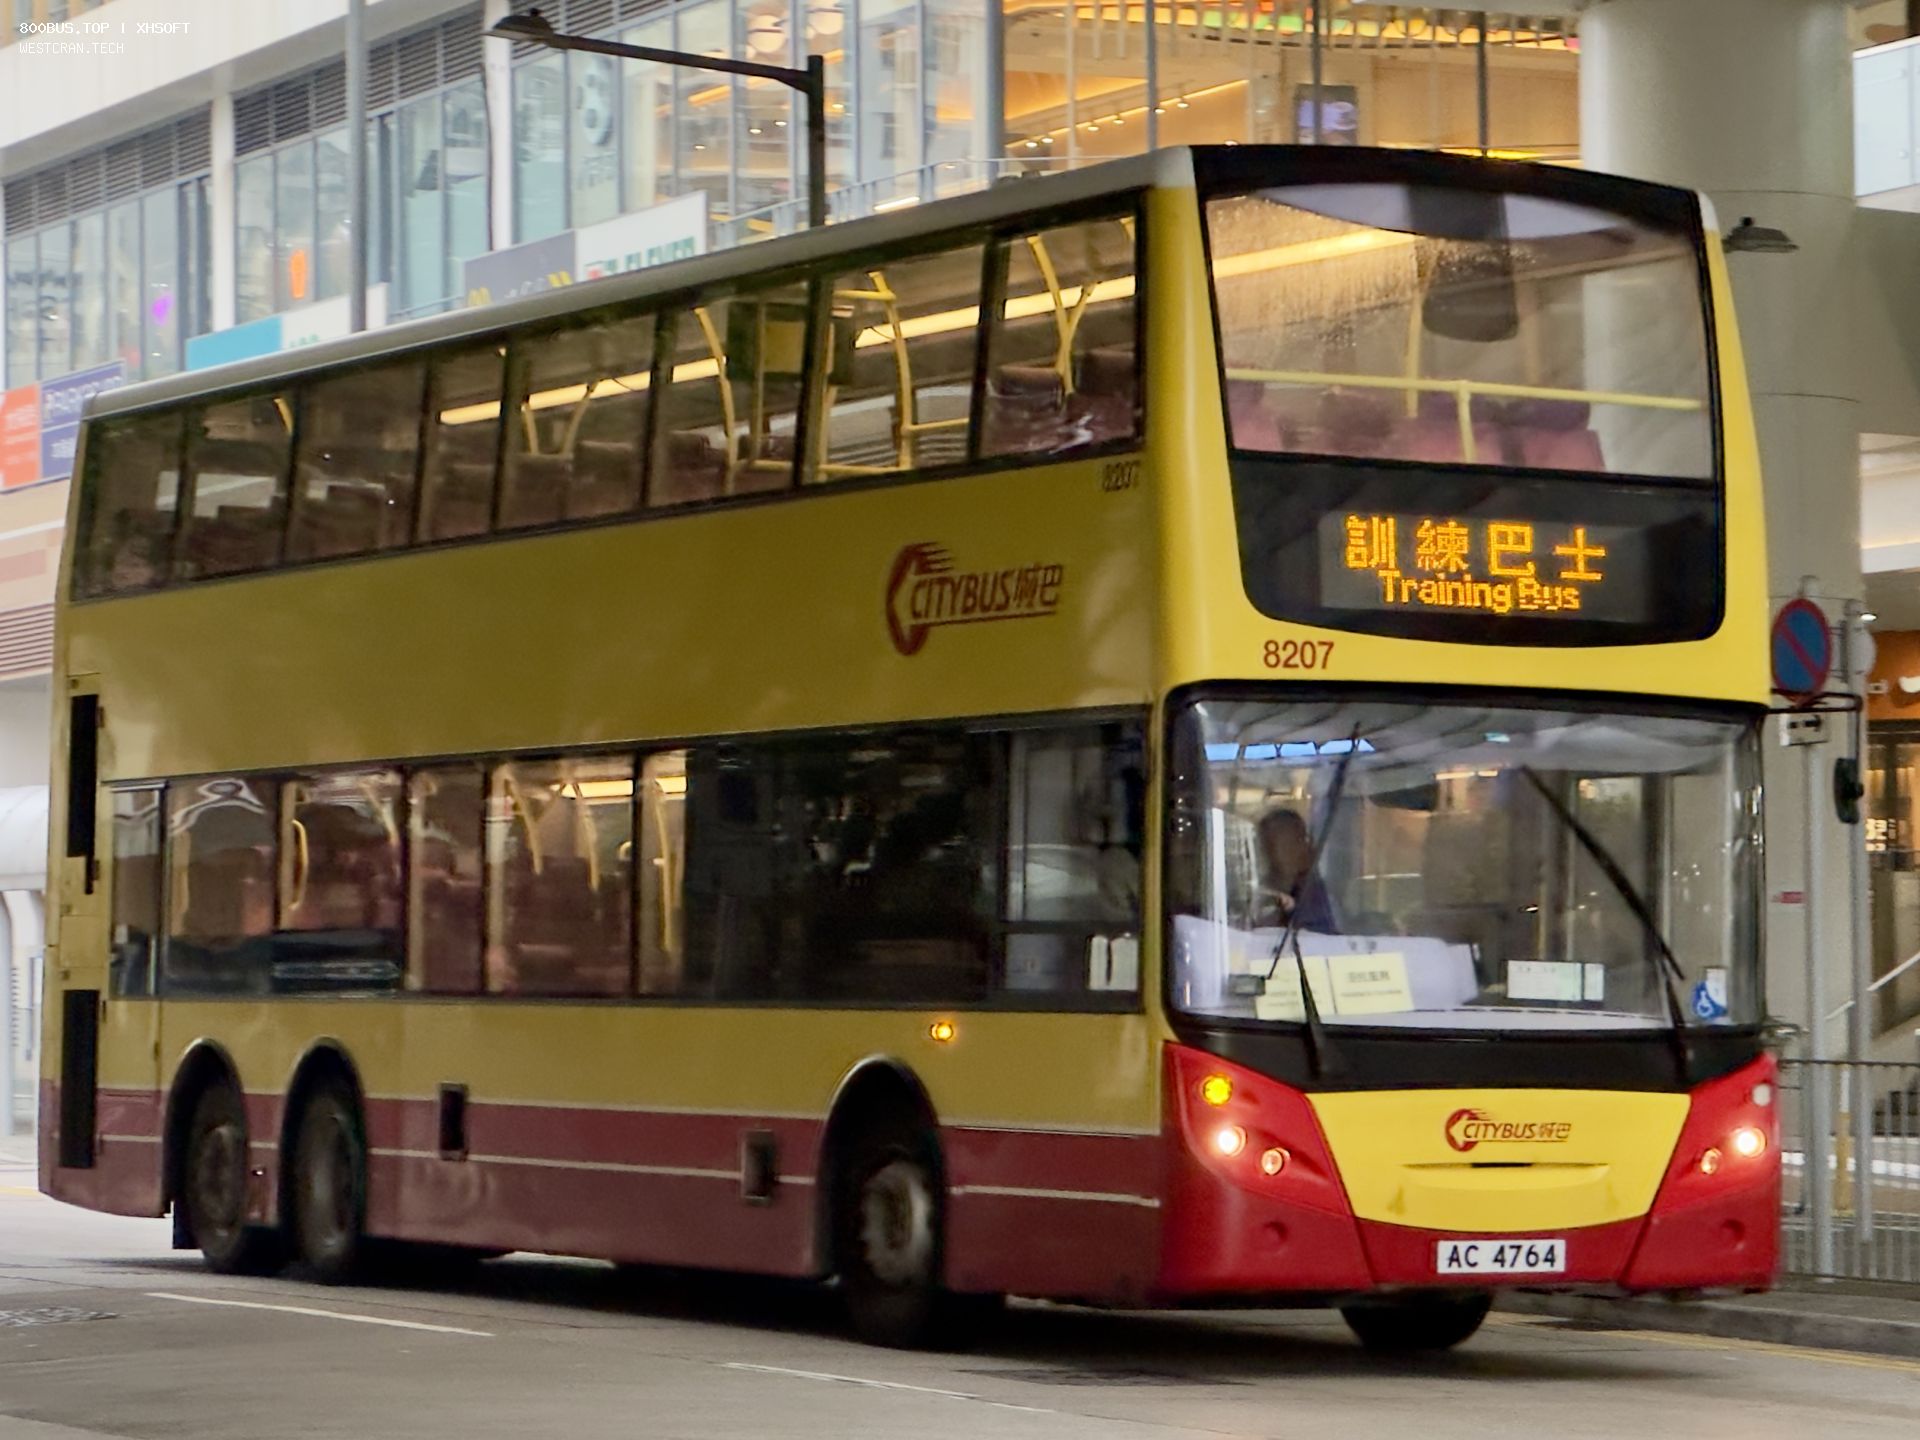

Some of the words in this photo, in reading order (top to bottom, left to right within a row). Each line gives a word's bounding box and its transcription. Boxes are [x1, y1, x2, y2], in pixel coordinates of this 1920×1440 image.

[1345, 514, 1606, 581] 訓練巴士
[911, 571, 1014, 620] CITYBUS
[1378, 569, 1512, 613] Training
[1518, 576, 1581, 610] Bus
[1263, 640, 1335, 669] 8207
[1463, 1122, 1537, 1139] CITYBUS
[1448, 1244, 1479, 1268] AC
[1493, 1244, 1556, 1269] 4764
